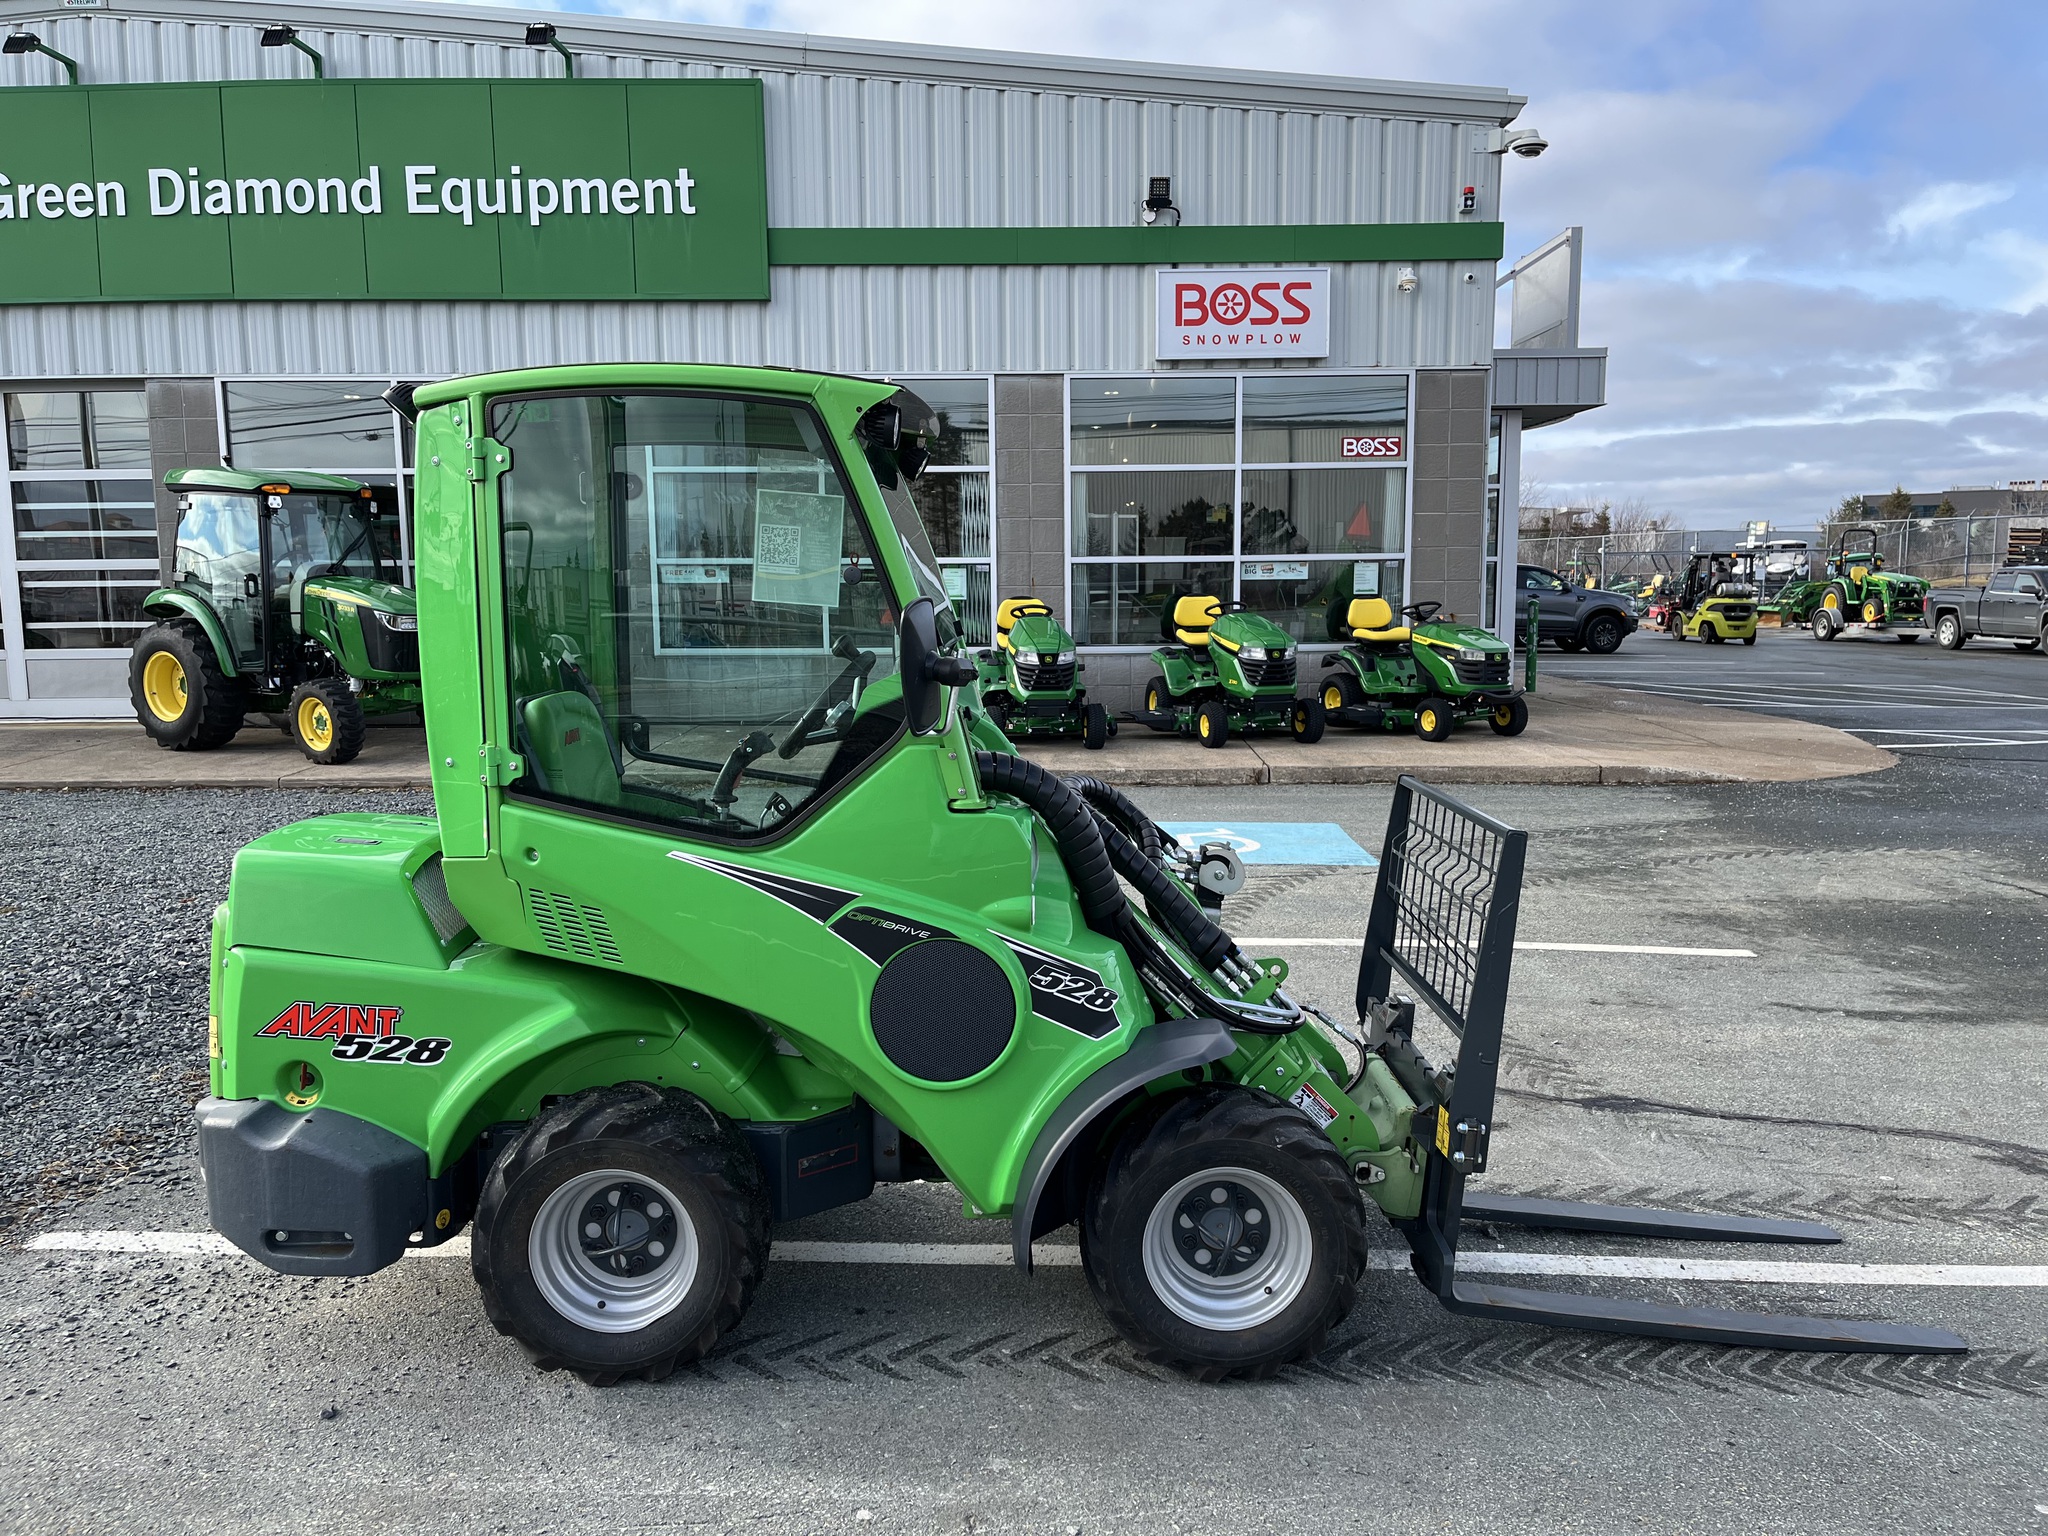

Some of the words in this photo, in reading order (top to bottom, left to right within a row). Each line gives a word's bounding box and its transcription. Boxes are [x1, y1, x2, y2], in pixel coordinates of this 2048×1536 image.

[148, 166, 382, 217] Diamond
[404, 165, 696, 226] Equipment
[1175, 282, 1312, 327] BOSS
[1182, 333, 1302, 345] SNOWPLOW
[1343, 437, 1400, 456] BOSS
[847, 911, 931, 939] OPTIDRIVE
[1028, 964, 1120, 1012] 528
[254, 1000, 403, 1041] AVANT
[331, 1033, 452, 1066] 528
